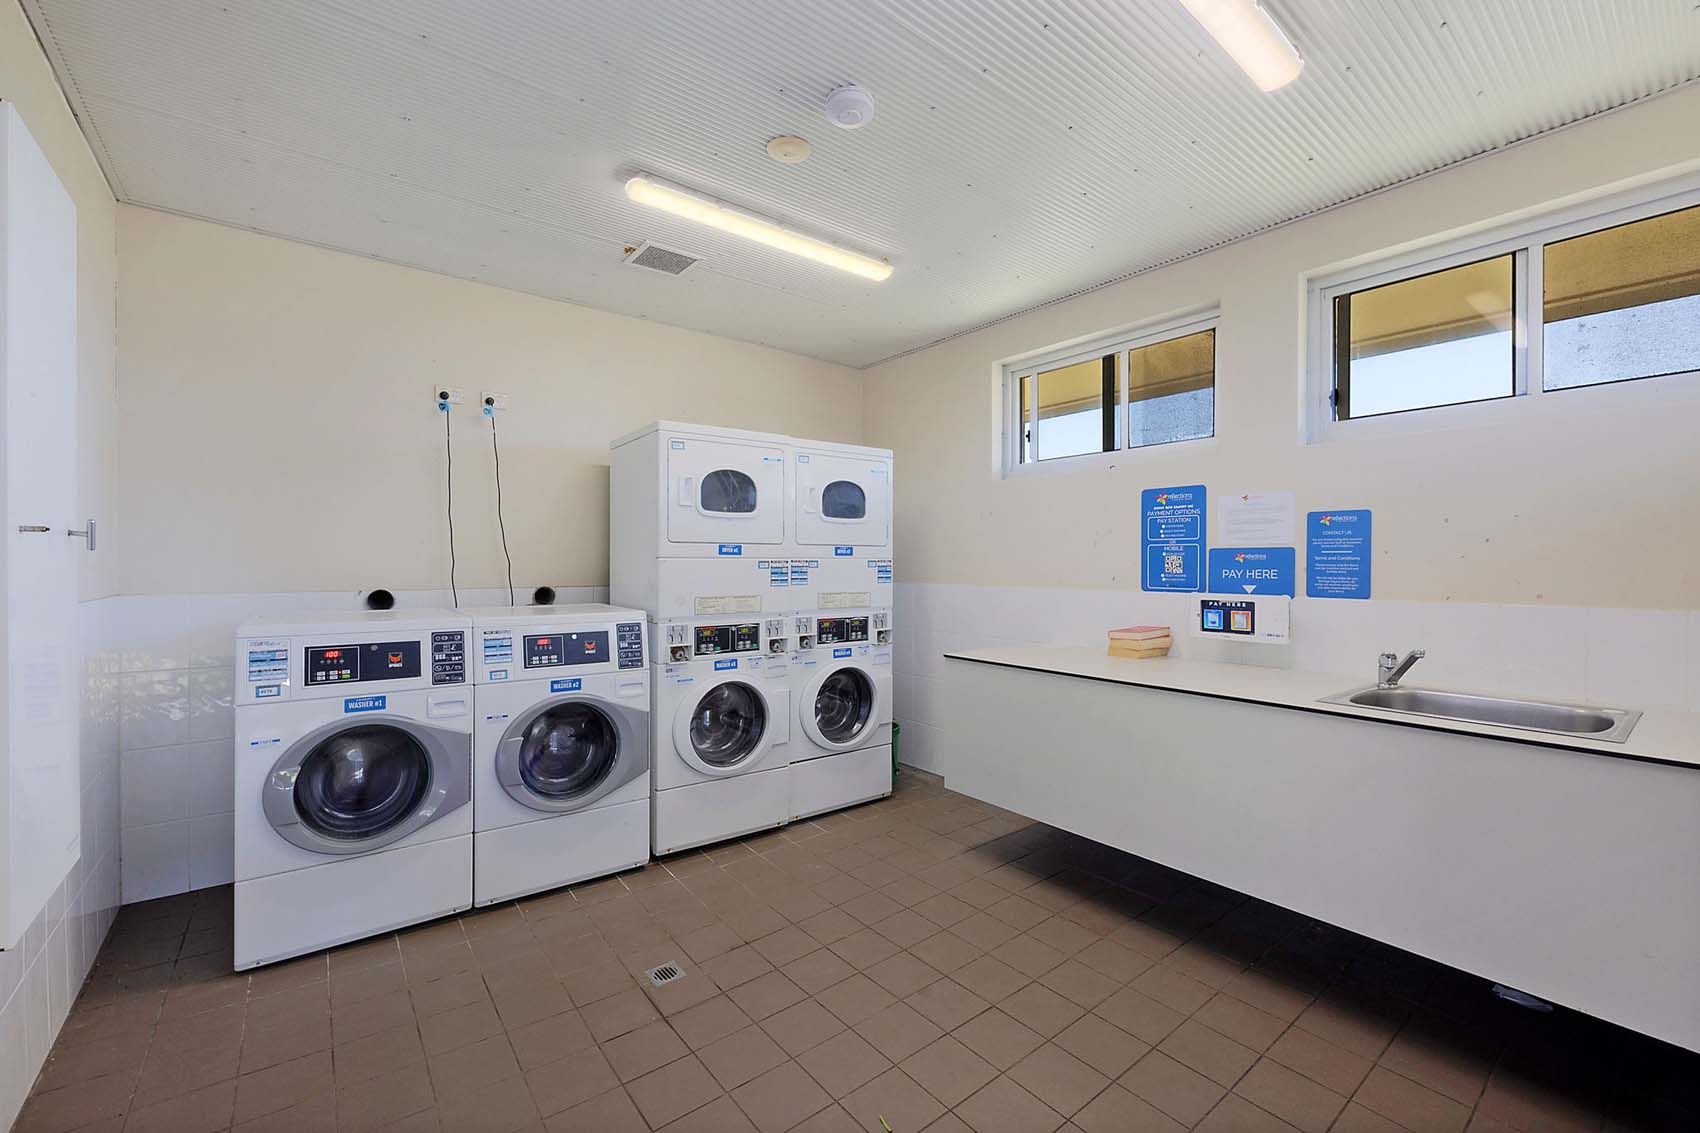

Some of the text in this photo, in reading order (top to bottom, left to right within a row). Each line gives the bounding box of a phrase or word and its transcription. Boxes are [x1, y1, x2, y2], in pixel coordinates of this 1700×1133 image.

[1222, 569, 1278, 579] PAY HERE
[348, 701, 374, 709] WASHER
